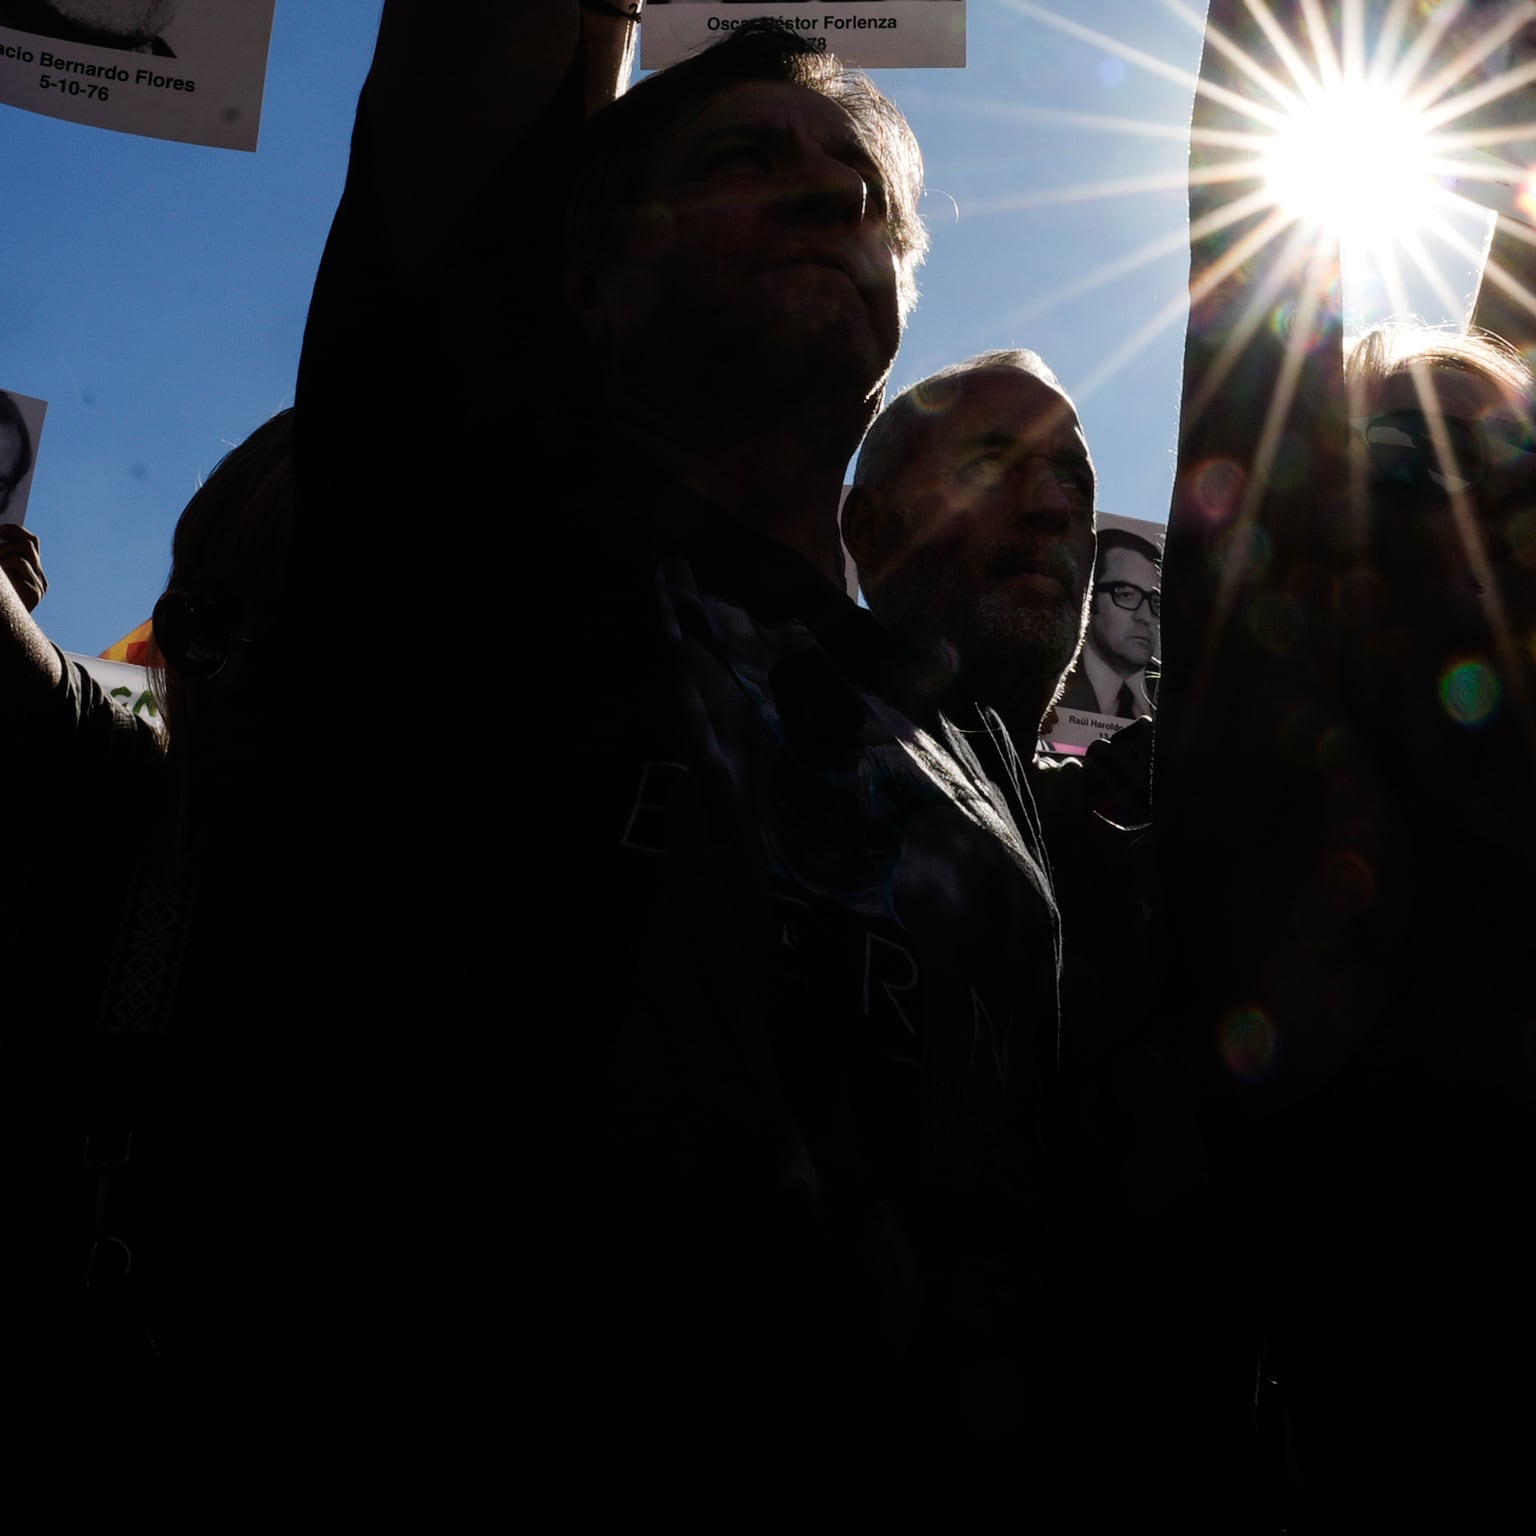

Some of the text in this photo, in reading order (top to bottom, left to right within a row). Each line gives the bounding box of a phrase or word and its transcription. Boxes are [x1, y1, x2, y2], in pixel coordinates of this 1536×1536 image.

[823, 15, 898, 30] Forlenza
[39, 51, 131, 83] Bernardo
[135, 68, 197, 93] Flores
[39, 74, 110, 102] 5-10-76
[1069, 715, 1089, 726] Raúl
